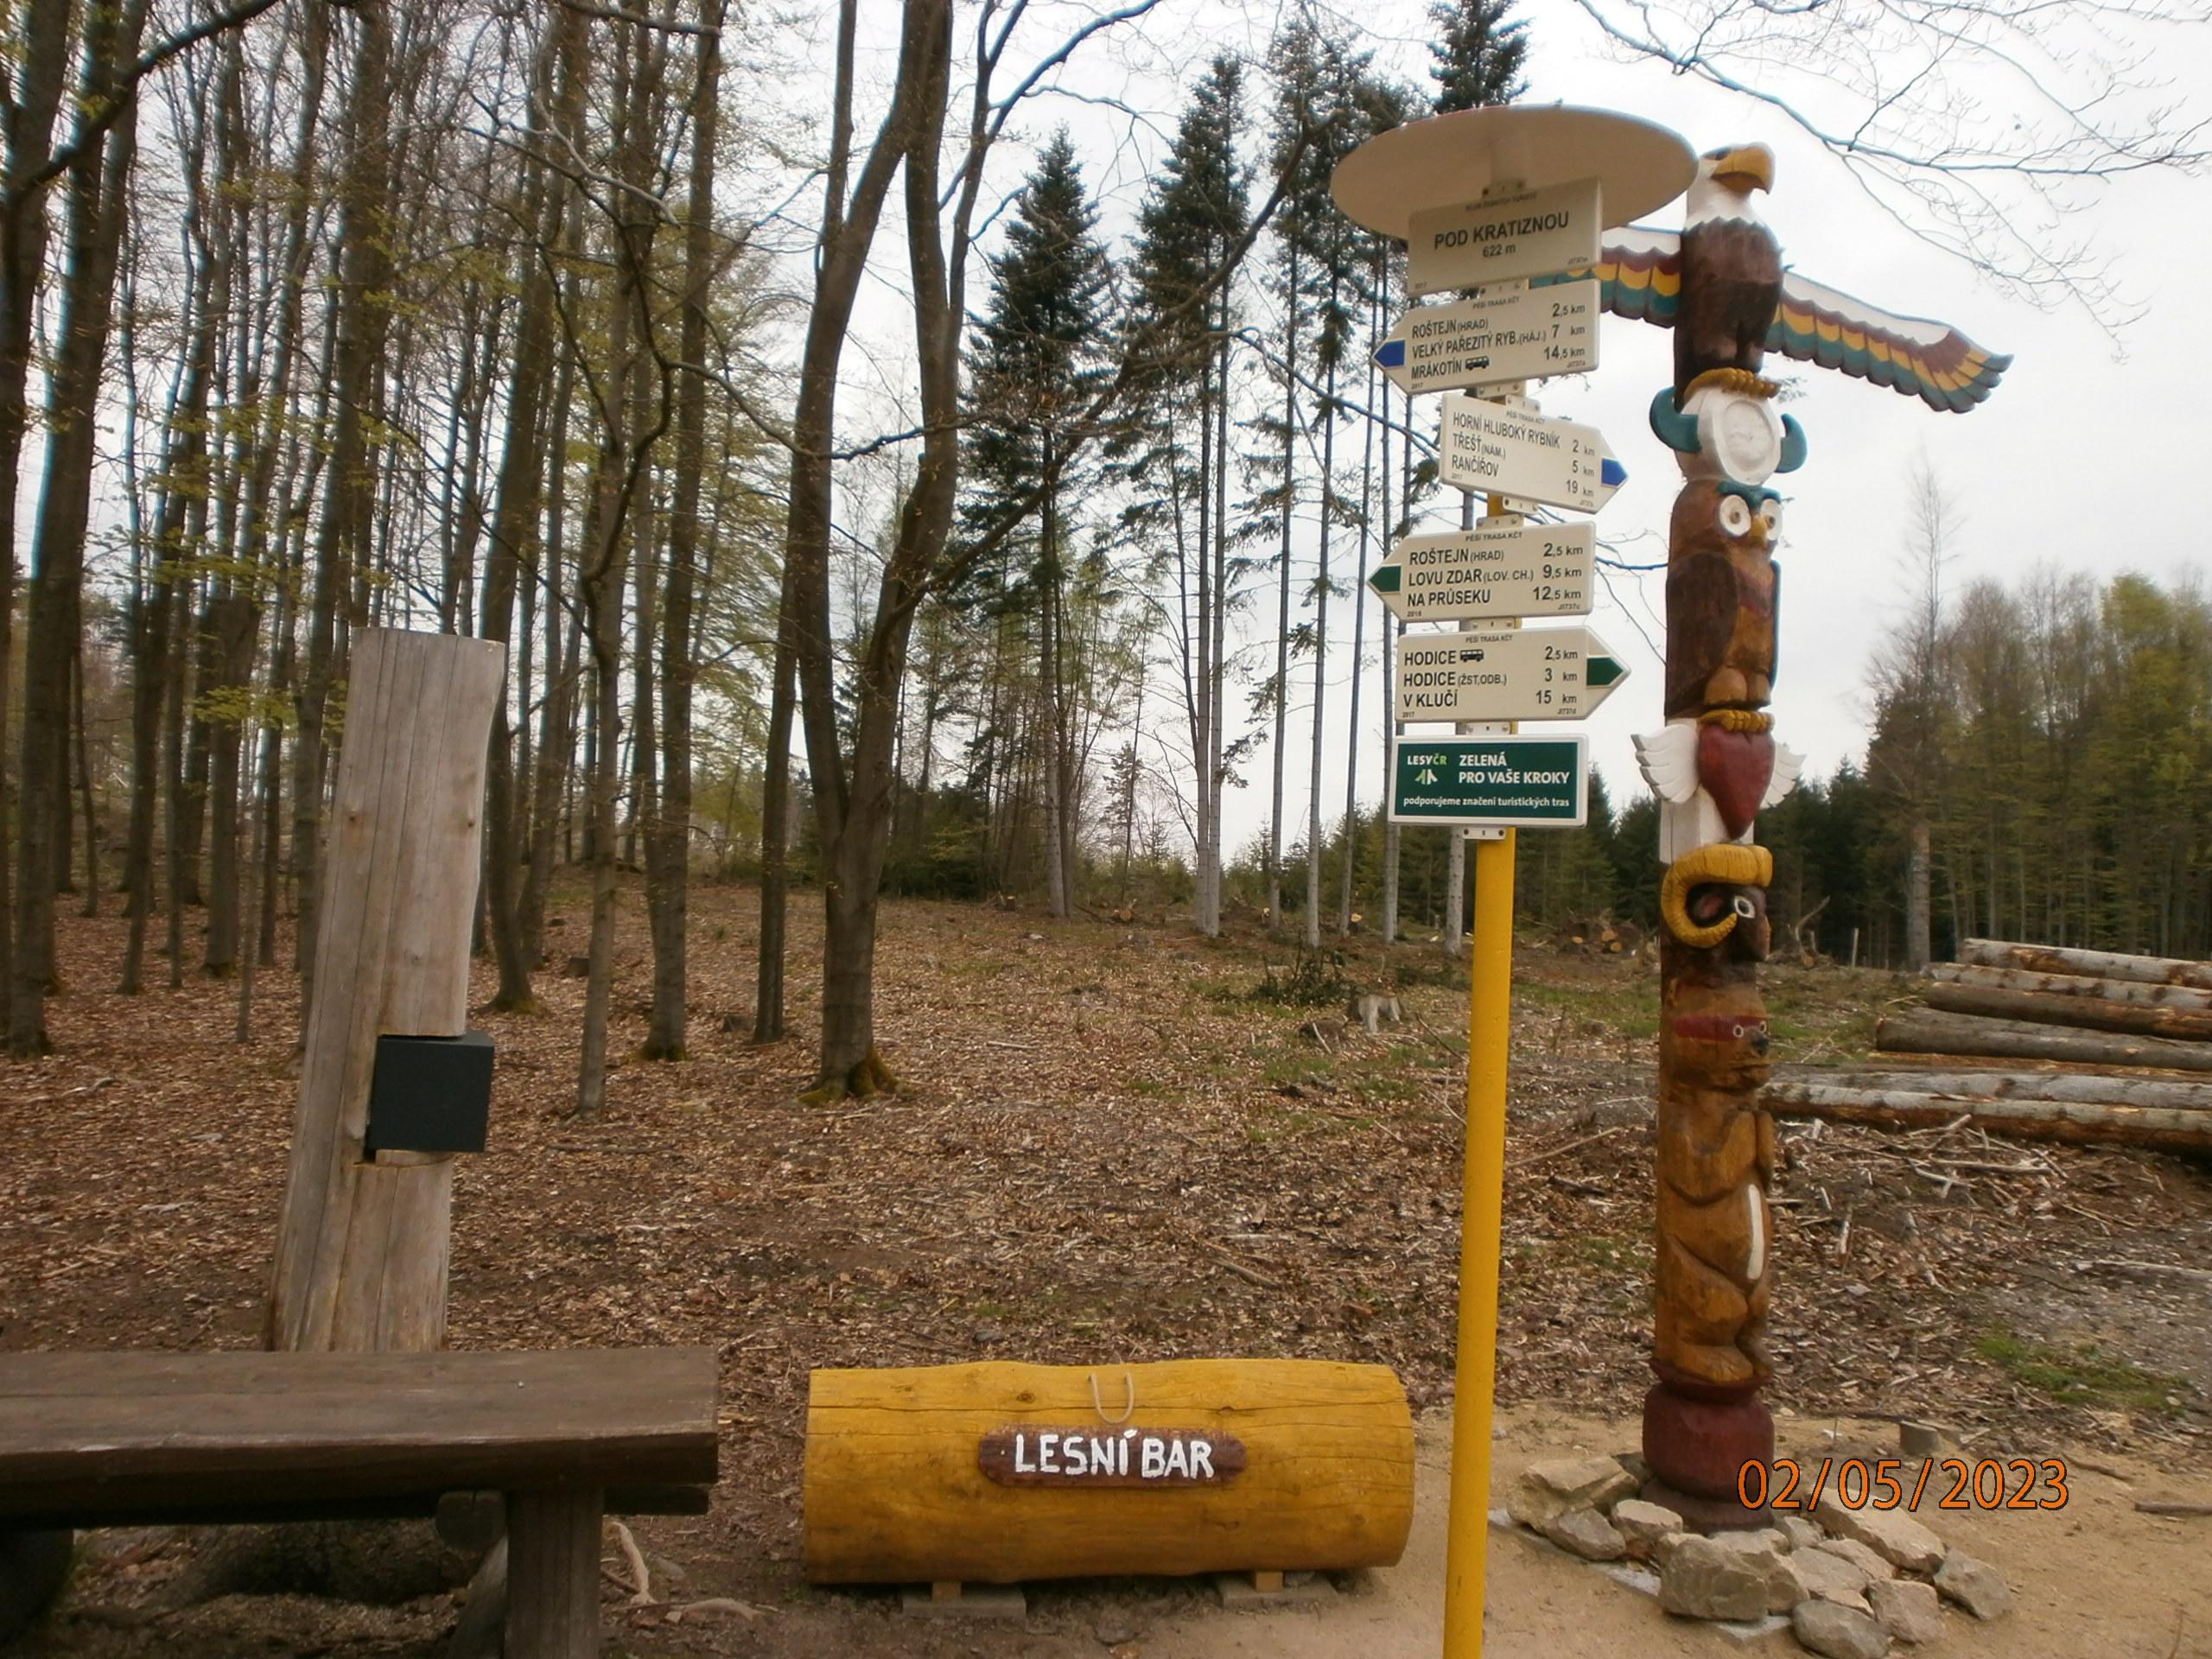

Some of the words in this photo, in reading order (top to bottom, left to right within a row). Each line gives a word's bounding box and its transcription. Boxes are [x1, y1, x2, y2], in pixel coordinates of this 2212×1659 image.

[1434, 230, 1468, 250] POD
[1472, 211, 1569, 243] KRATIZNOU
[1483, 245, 1503, 257] 622
[1505, 244, 1516, 254] m
[1488, 298, 1506, 308] TRASA
[1570, 303, 1586, 315] km
[1412, 342, 1442, 359] VELKÝ
[1446, 333, 1492, 355] PAŘEZITÝ
[1552, 324, 1560, 338] 7
[1570, 324, 1586, 335] km
[1411, 357, 1462, 379] MRÁKOTÍN
[1570, 346, 1586, 358] km
[1452, 411, 1482, 429] HORNÍ
[1484, 418, 1527, 442] HLUBOKÝ
[1528, 428, 1560, 449] RYBNÍK
[1573, 439, 1580, 453] 2
[1584, 446, 1595, 456] km
[1452, 454, 1499, 478] RANČÍŘOV
[1566, 480, 1579, 494] 19
[1582, 487, 1594, 498] km
[1572, 460, 1579, 474] 5
[1583, 467, 1595, 477] km
[1483, 532, 1507, 541] TRASA
[1566, 544, 1583, 555] km
[1408, 570, 1443, 587] LOVU
[1565, 566, 1582, 577] km
[1408, 592, 1425, 607] NA
[1428, 588, 1491, 606] PRŮSEKU
[1564, 588, 1581, 600] km
[1404, 650, 1456, 666] HODICE
[1563, 650, 1578, 660] km
[1545, 668, 1553, 683] 3
[1562, 671, 1578, 681] km
[1403, 694, 1413, 708] V
[1415, 690, 1458, 708] KLUČÍ
[1535, 690, 1552, 705] 15
[1562, 694, 1577, 703] km
[1459, 752, 1507, 766] ZELENÁ
[1459, 772, 1485, 785] PRO
[1488, 769, 1521, 784] VAŠE
[1523, 772, 1570, 785] KROKY
[1403, 797, 1461, 808] podporujeme
[1462, 797, 1496, 806] značení
[1497, 796, 1550, 809] turistických
[1552, 798, 1570, 807] tras
[1015, 1428, 1139, 1476] LESNÍ
[1141, 1438, 1215, 1480] BAR
